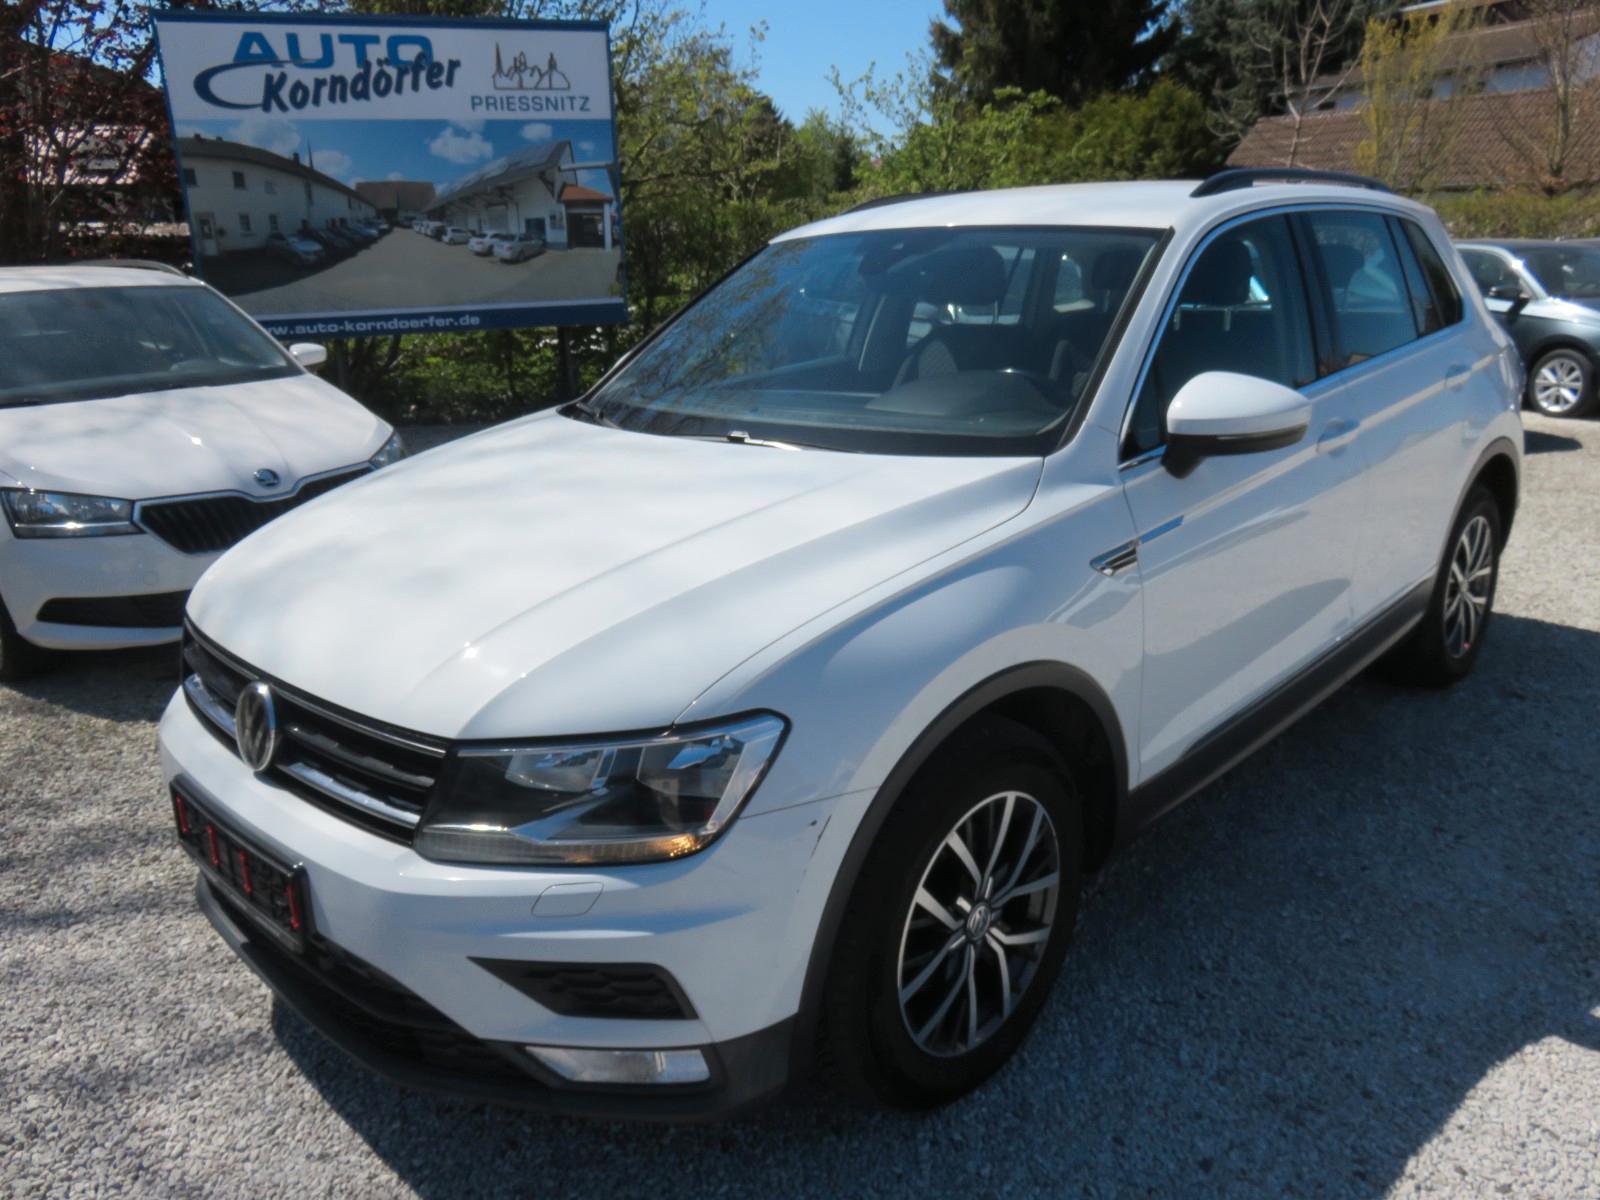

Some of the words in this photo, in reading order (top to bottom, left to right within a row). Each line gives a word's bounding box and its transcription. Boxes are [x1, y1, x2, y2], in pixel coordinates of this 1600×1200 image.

[233, 31, 434, 69] AUTO
[261, 51, 462, 114] Korndörfer
[470, 95, 592, 112] PRIESSNITZ
